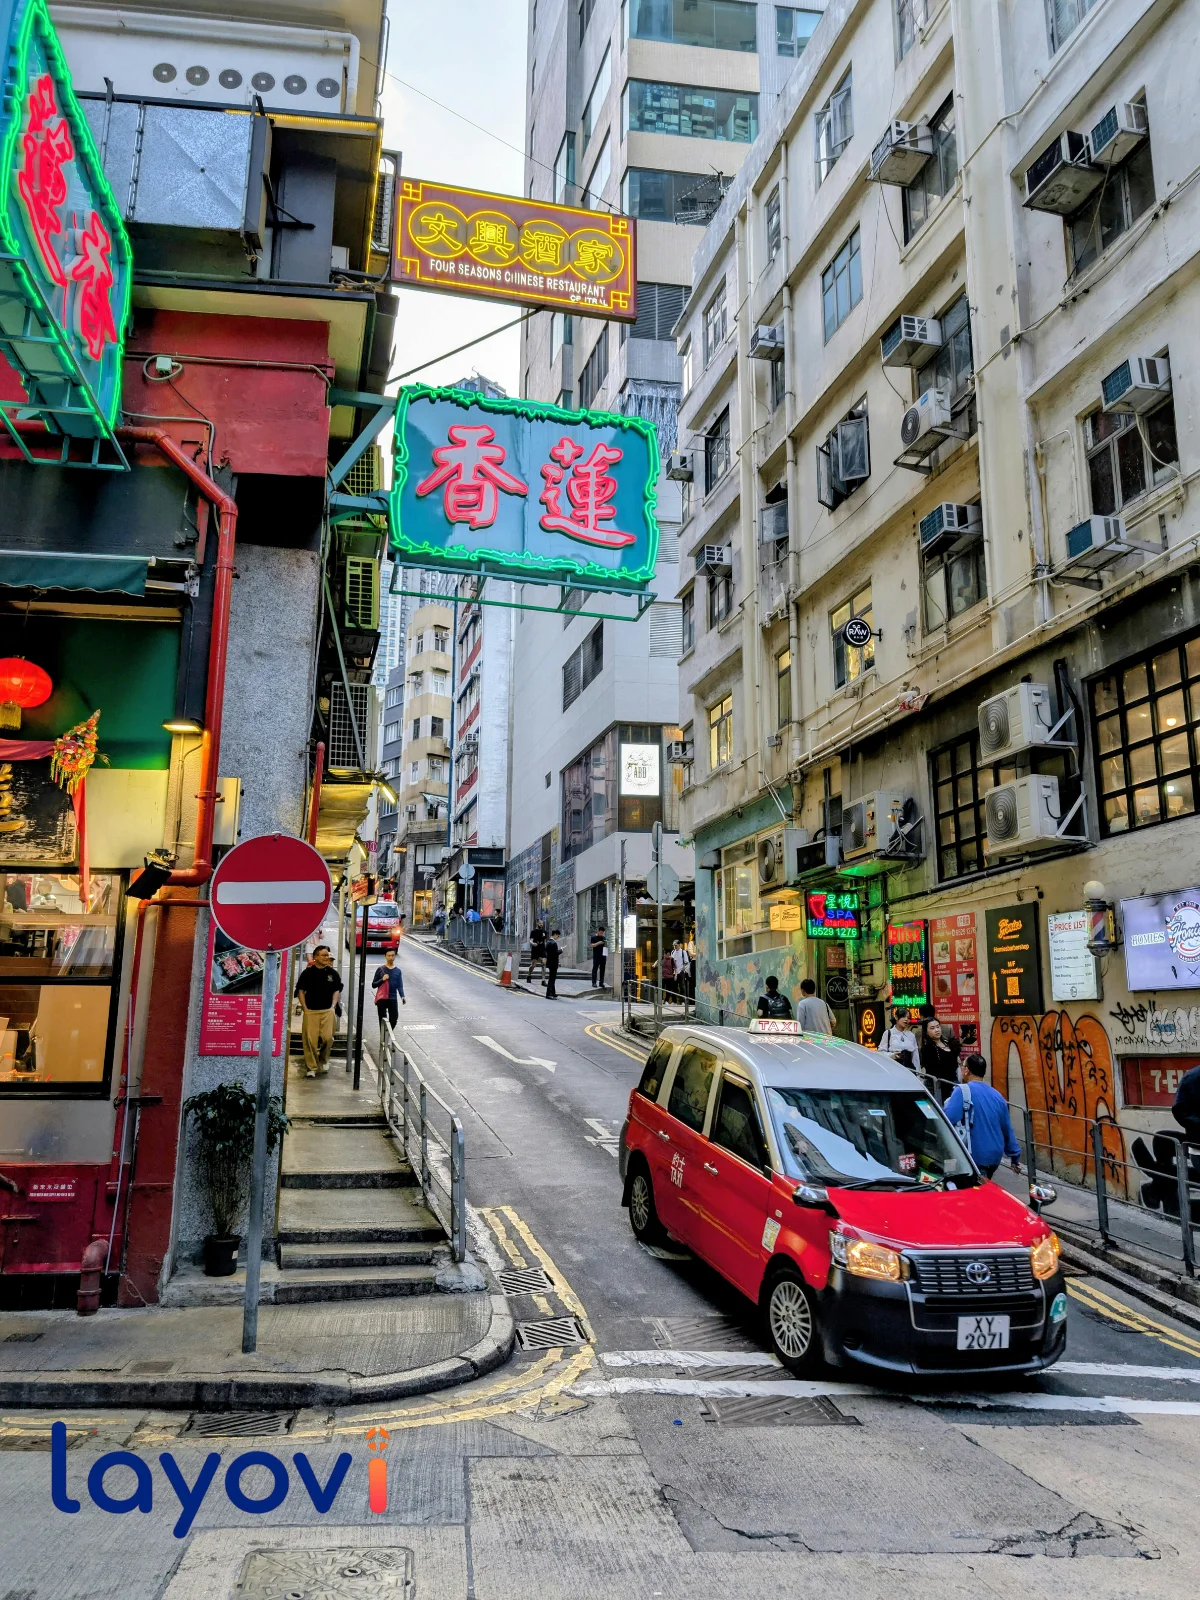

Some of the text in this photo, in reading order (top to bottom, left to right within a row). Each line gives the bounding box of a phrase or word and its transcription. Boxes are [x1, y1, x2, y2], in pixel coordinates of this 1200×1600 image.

[415, 212, 614, 274] 文興酒家
[430, 259, 456, 274] FOUR
[458, 264, 502, 281] SEASONS
[546, 278, 606, 297] RESTAURANT
[848, 626, 868, 636] RAW
[827, 909, 855, 919] SPA
[812, 918, 857, 928] 1/F Starlight
[1054, 920, 1087, 932] PRICE LIST
[812, 927, 857, 937] 6529 1276
[892, 927, 921, 944] Bliss
[1131, 932, 1165, 946] HOMIES
[893, 942, 921, 962] SPA
[758, 1020, 798, 1032] TAXI
[671, 1151, 686, 1173] 的士
[670, 1166, 683, 1188] TAXI
[974, 1317, 996, 1333] XY
[965, 1332, 1003, 1349] 2071
